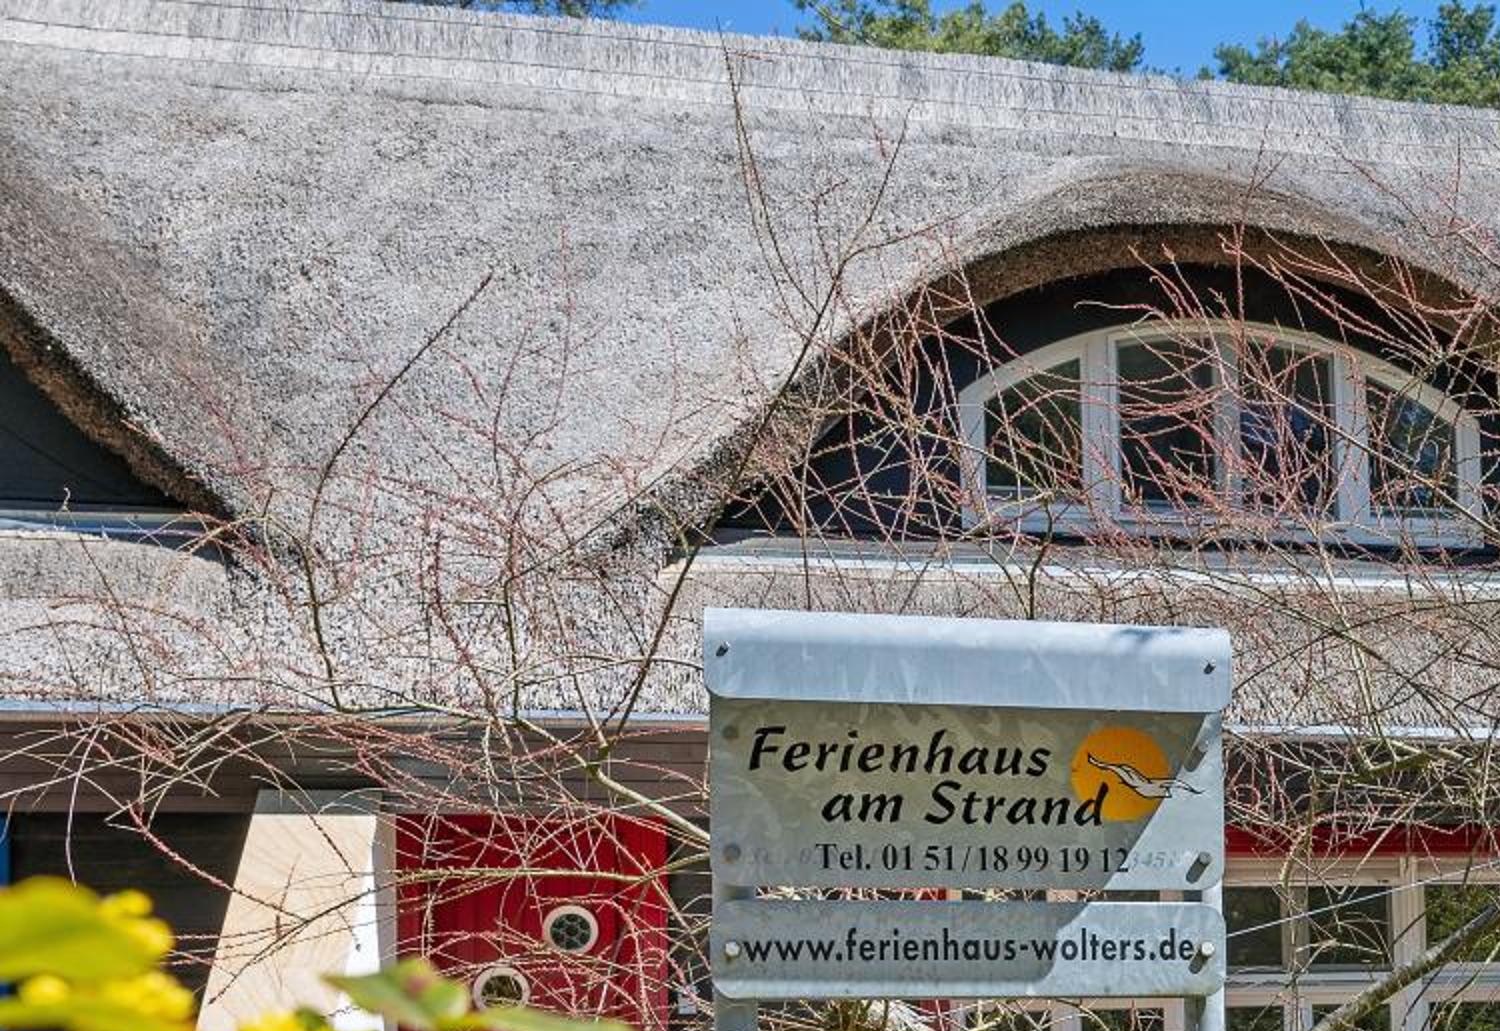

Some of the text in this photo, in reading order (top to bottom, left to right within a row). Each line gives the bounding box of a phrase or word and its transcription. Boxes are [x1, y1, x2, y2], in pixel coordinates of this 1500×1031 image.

[748, 725, 1052, 778] Ferienhaus
[821, 779, 1110, 828] am Strand
[815, 842, 871, 870] Tel.
[743, 927, 1195, 963] www.ferienhaus-wolters.de
